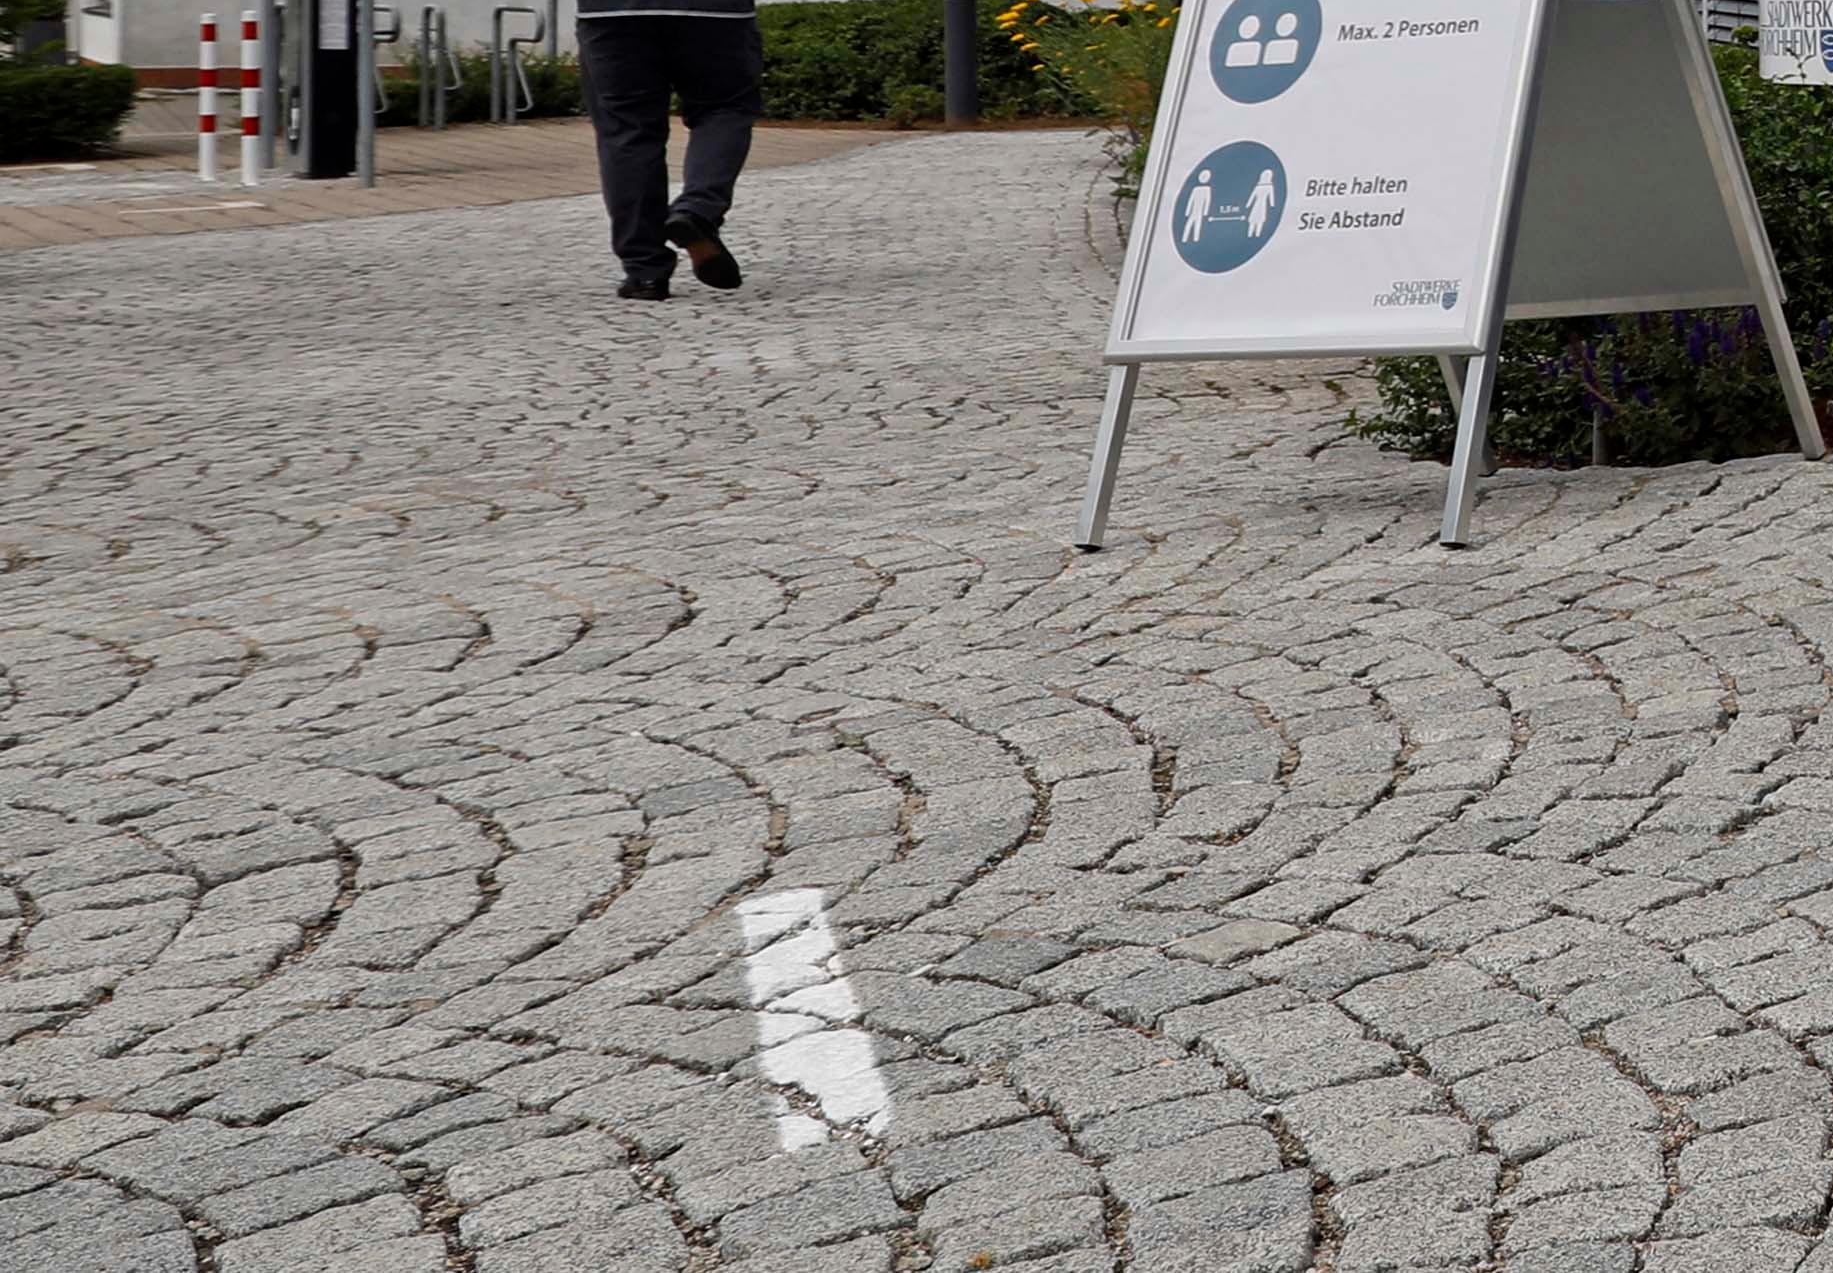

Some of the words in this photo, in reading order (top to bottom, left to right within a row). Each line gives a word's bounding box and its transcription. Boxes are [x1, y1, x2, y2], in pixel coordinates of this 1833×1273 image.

[1336, 23, 1378, 42] Max.
[1382, 21, 1394, 39] 2
[1397, 18, 1480, 37] Personen
[1304, 179, 1347, 198] Bitte
[1350, 175, 1408, 195] halten
[1298, 211, 1325, 230] Sie
[1328, 207, 1405, 229] Abstand
